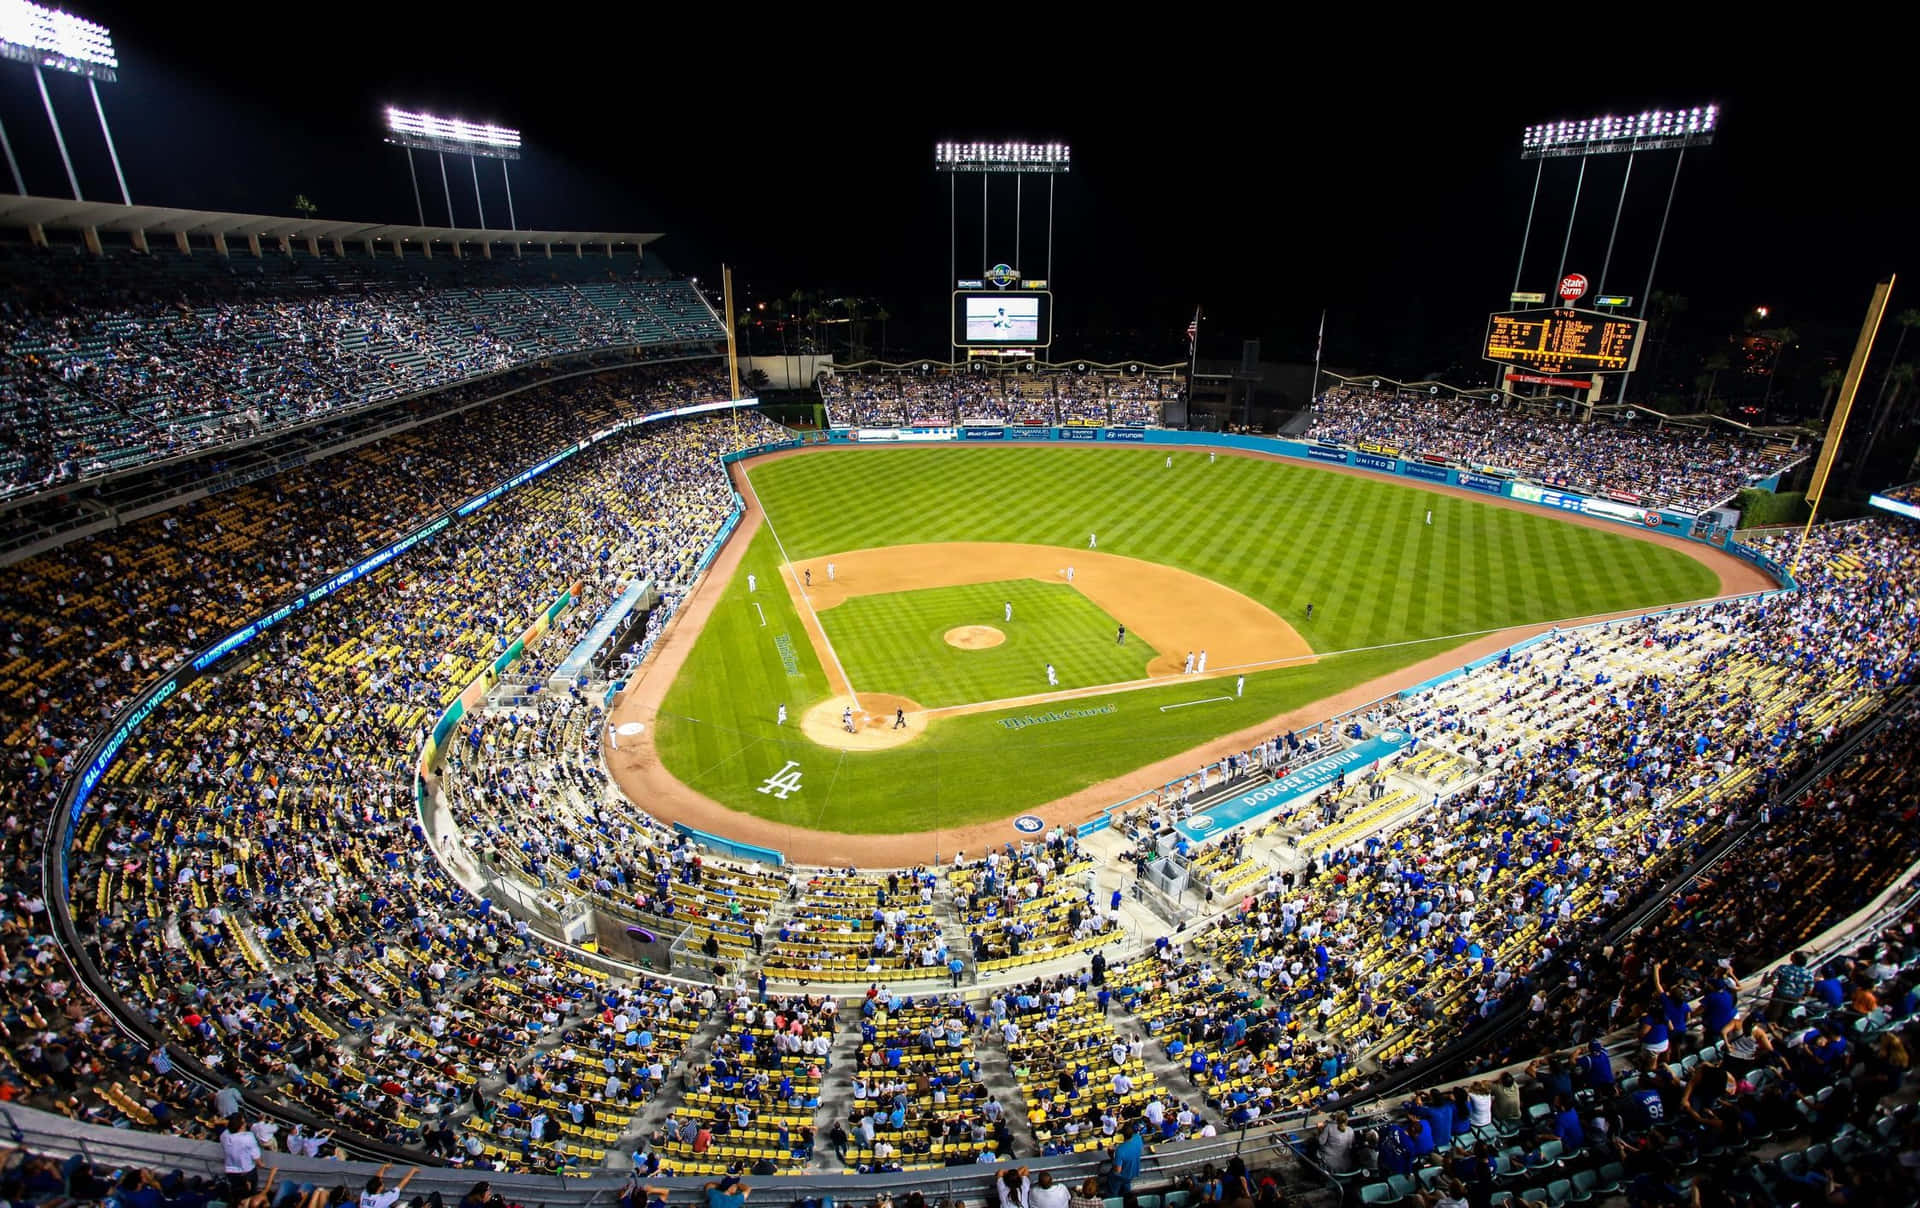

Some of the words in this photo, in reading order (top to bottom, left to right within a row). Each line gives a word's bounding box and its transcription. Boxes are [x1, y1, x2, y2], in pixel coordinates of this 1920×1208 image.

[1563, 279, 1584, 288] State
[1560, 286, 1582, 296] Farm
[1356, 457, 1386, 468] UNITED
[1647, 515, 1658, 524] 76
[309, 587, 328, 602] RIDE
[328, 582, 337, 591] IT
[337, 571, 354, 586] NOW
[99, 723, 128, 769] STUDIOS
[126, 680, 177, 732] HOLLYWOOD
[756, 760, 803, 799] LA
[1243, 775, 1305, 806] DODGER
[1307, 751, 1362, 781] STADIUM
[1297, 780, 1318, 793] SINCE
